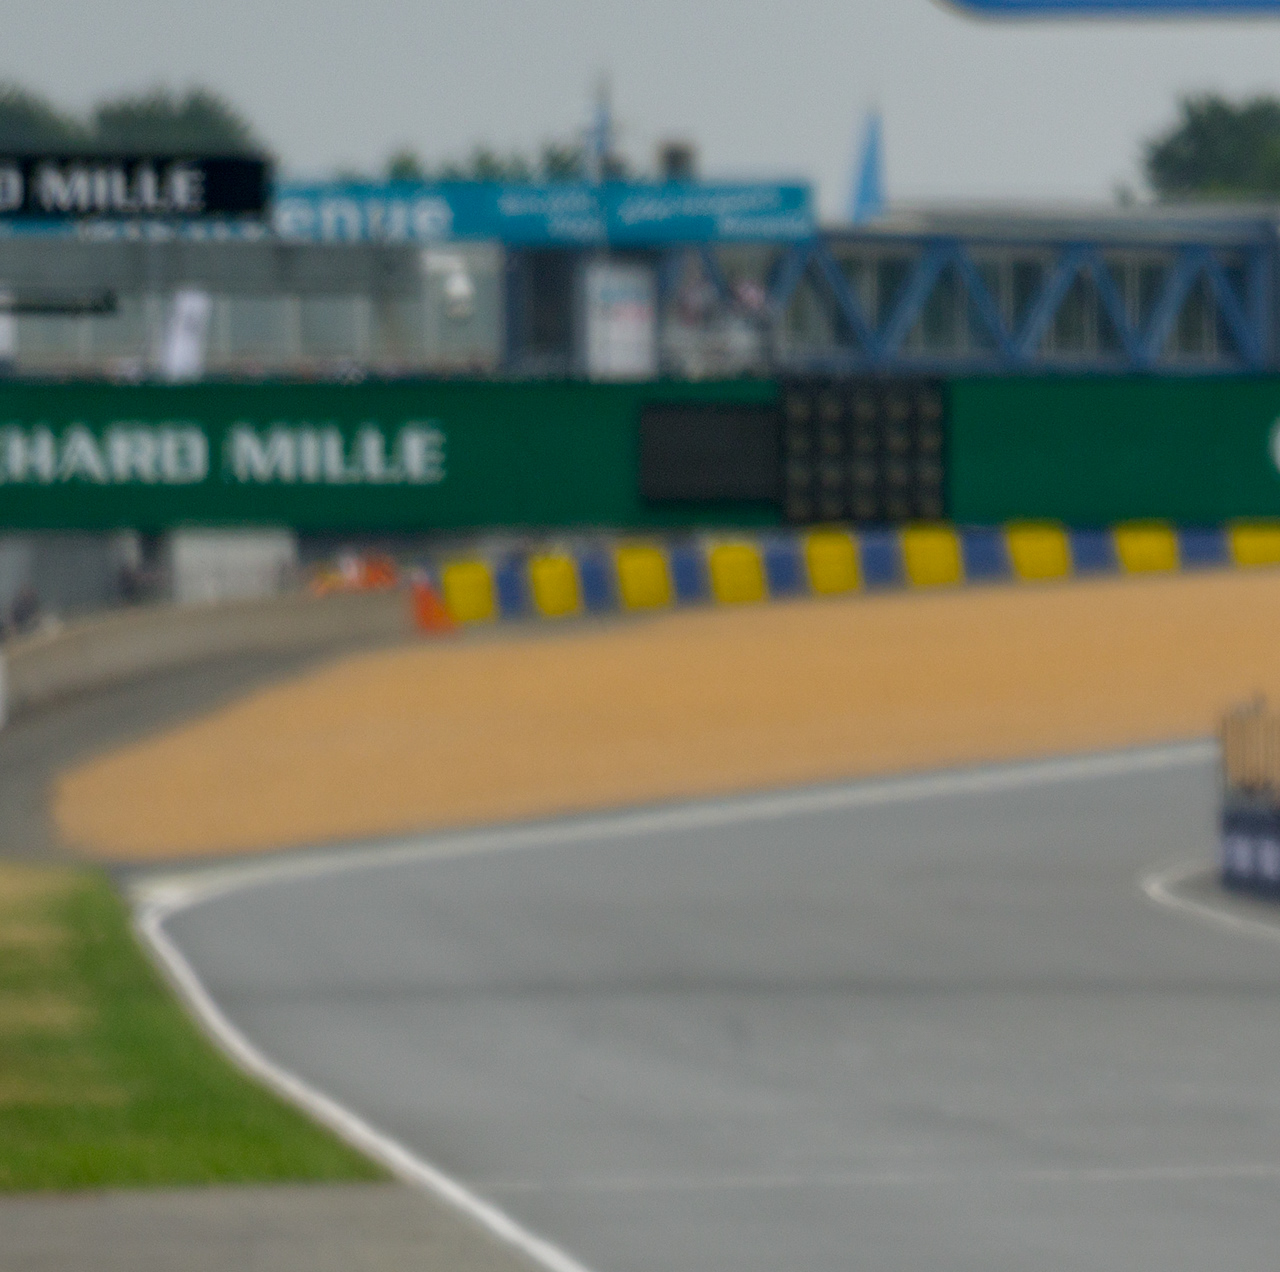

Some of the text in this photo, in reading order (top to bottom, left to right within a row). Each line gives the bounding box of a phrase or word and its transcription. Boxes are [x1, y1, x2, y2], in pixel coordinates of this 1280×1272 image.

[39, 164, 206, 211] MILLE
[0, 421, 447, 484] HARD MILLE
